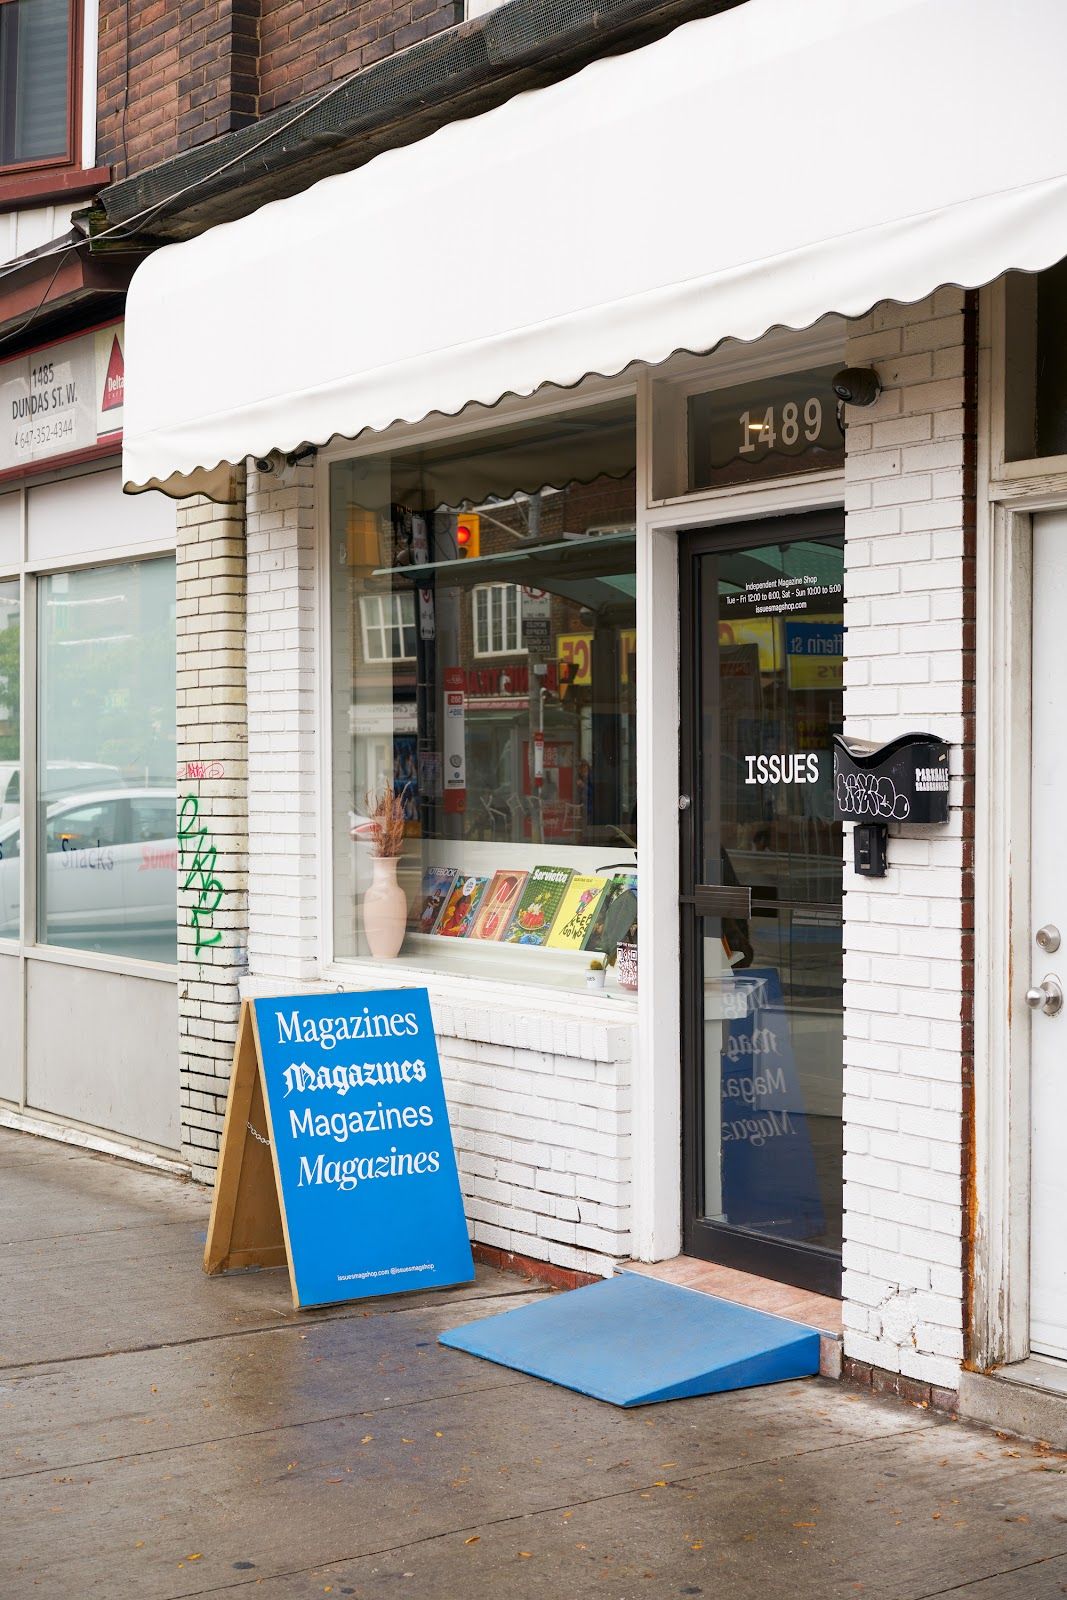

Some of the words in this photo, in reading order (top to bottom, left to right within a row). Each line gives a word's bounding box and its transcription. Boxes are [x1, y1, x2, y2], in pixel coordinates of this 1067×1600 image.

[32, 363, 54, 387] 1485
[12, 391, 49, 420] DUNDAS
[51, 386, 64, 409] ST.
[66, 382, 78, 404] W.
[20, 419, 73, 448] 647-352-4344
[738, 397, 822, 454] 1489
[726, 596, 736, 605] Tue
[739, 595, 747, 603] Fri
[761, 592, 768, 600] to
[781, 589, 791, 599] Sat
[795, 588, 806, 597] Sun
[807, 586, 821, 595] 10:00
[821, 586, 828, 594] to
[829, 584, 842, 593] 5:00
[745, 579, 777, 591] Independent
[778, 577, 802, 588] Magazine
[803, 575, 818, 585] Shop
[755, 601, 807, 613] issuesmagshop.com
[745, 753, 820, 784] ISSUES
[61, 838, 114, 871] Snacks
[428, 867, 458, 877] OTEBOOK
[532, 868, 568, 883] Serviette
[274, 1007, 419, 1050] Magazines
[282, 1057, 427, 1098] Magazines
[289, 1102, 433, 1143] Magazines
[297, 1147, 440, 1191] Magazines
[337, 1270, 390, 1281] issuesmagshop.com
